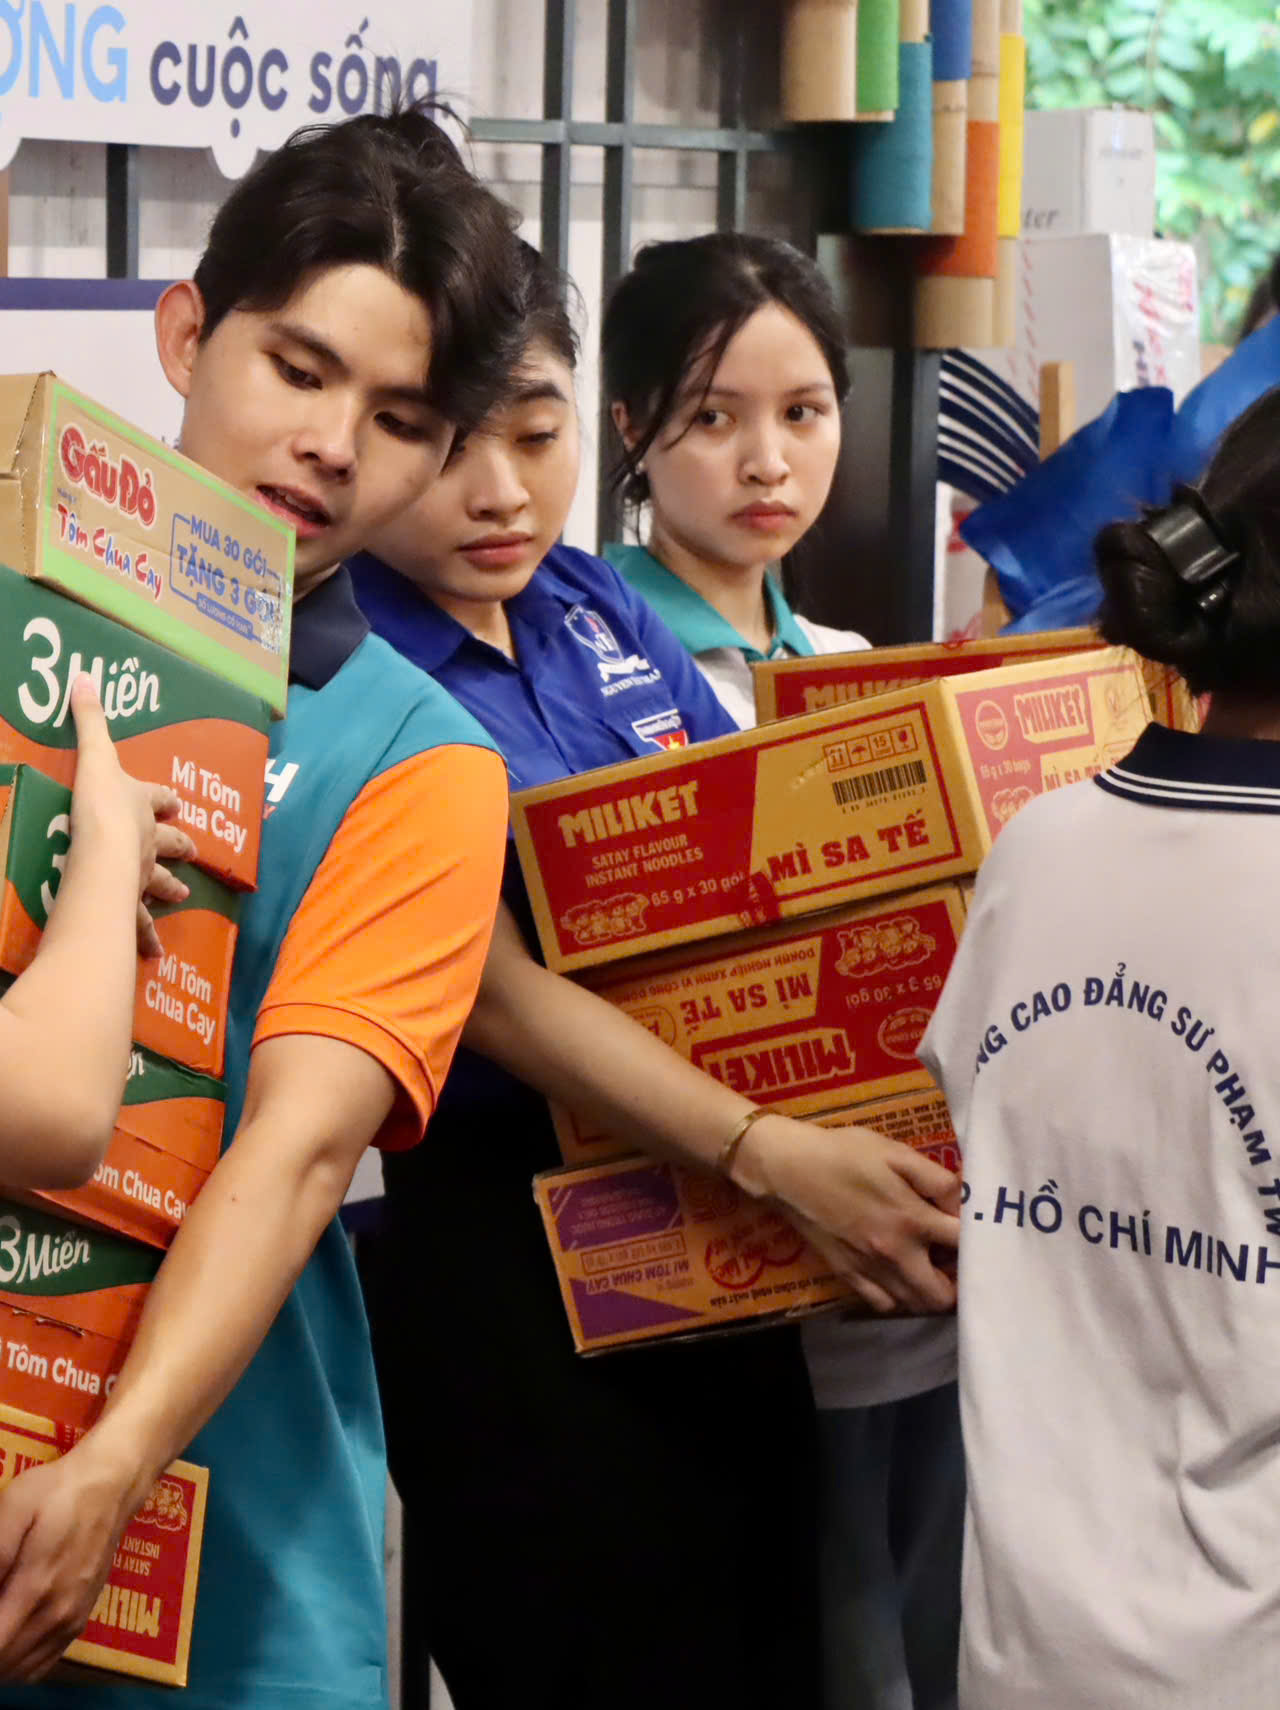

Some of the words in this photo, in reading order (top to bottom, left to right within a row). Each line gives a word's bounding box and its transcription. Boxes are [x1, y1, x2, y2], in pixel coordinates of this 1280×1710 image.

[149, 15, 289, 139] cuộc
[57, 503, 89, 548] Tôm
[93, 527, 131, 575] Chua
[134, 552, 163, 600] Cay
[190, 514, 221, 552] MUA
[223, 535, 240, 562] 30
[243, 547, 267, 578] GÓI
[176, 543, 226, 597] TẶNG
[231, 577, 240, 606] 3
[1014, 685, 1087, 736] MILIKET
[872, 735, 887, 748] 15
[171, 755, 196, 792] Mì
[199, 767, 241, 814] Tôm
[173, 788, 209, 833] ua
[210, 809, 248, 854] Cay
[557, 779, 699, 849] MILIKET
[584, 863, 640, 889] INSTANT
[643, 847, 704, 873] NOODLES
[591, 848, 630, 871] SATAY
[633, 833, 689, 858] FLAVOUR
[767, 842, 814, 883] MÌ
[820, 833, 871, 870] SA
[878, 810, 931, 856] TẾ
[650, 889, 670, 907] 65
[673, 889, 685, 905] g
[687, 886, 697, 898] x
[698, 877, 718, 895] 30
[157, 953, 177, 985] Mì
[179, 960, 212, 1005] Tôm
[727, 982, 769, 1014] SA
[774, 971, 813, 1011] MÌ
[896, 982, 908, 996] x
[923, 974, 942, 993] 65
[145, 979, 184, 1025] Chua
[186, 1001, 217, 1046] Cay
[678, 994, 724, 1036] TẾ
[1011, 981, 1073, 1032] CAO
[1082, 961, 1169, 1022] ĐẲNG
[1170, 1005, 1215, 1053] SƯ
[1206, 1048, 1273, 1168] PHẠM
[122, 1169, 162, 1210] Chua
[1077, 1205, 1153, 1257] CHÍ
[585, 1274, 610, 1294] CAY
[6, 1341, 49, 1380] Tôm
[51, 1357, 102, 1396] Chua
[122, 1535, 161, 1560] INSTANT
[123, 1555, 152, 1577] SATAY
